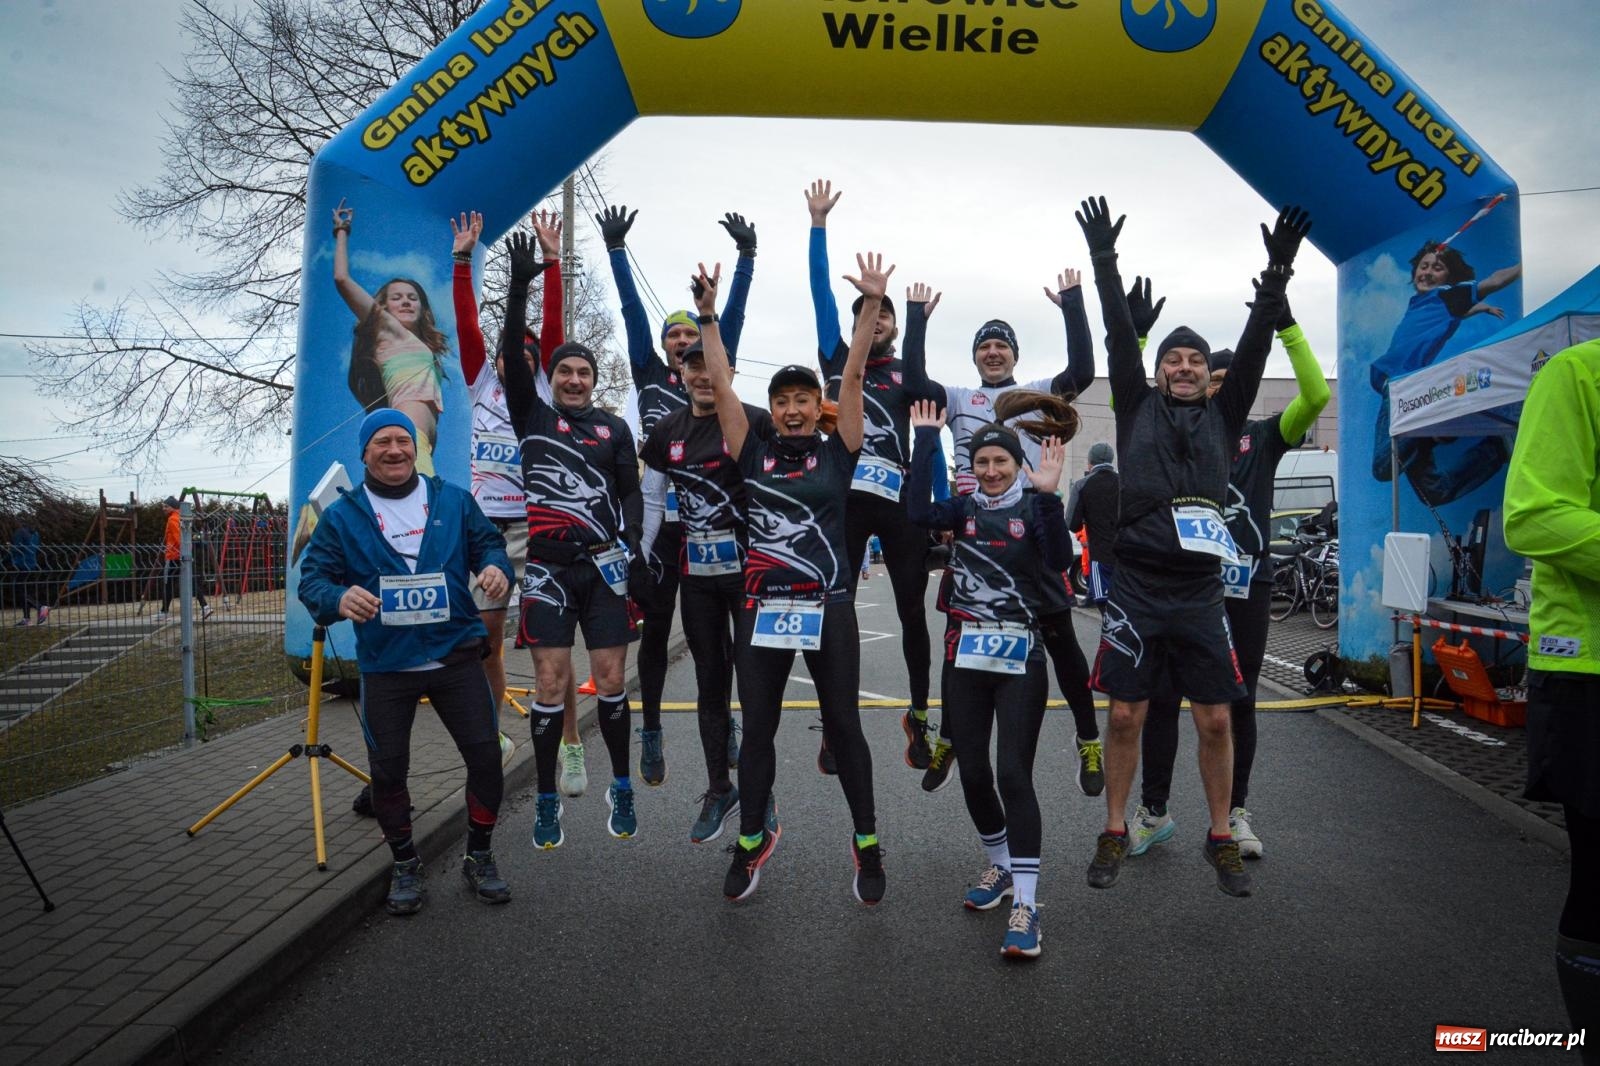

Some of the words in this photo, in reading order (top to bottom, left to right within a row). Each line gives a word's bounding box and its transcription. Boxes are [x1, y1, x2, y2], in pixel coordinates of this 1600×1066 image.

[822, 12, 1039, 55] Wielkie
[402, 12, 597, 186] aktywnych
[1293, 0, 1394, 95] Gmina
[1395, 91, 1482, 175] ludzi
[362, 52, 476, 150] Gmina
[1261, 33, 1446, 208] aktywnych
[481, 443, 516, 462] 209
[862, 465, 888, 483] 29
[1190, 520, 1230, 547] 192
[698, 543, 721, 563] 91
[393, 588, 438, 610] 109
[774, 613, 803, 634] 68
[972, 635, 1019, 657] 197
